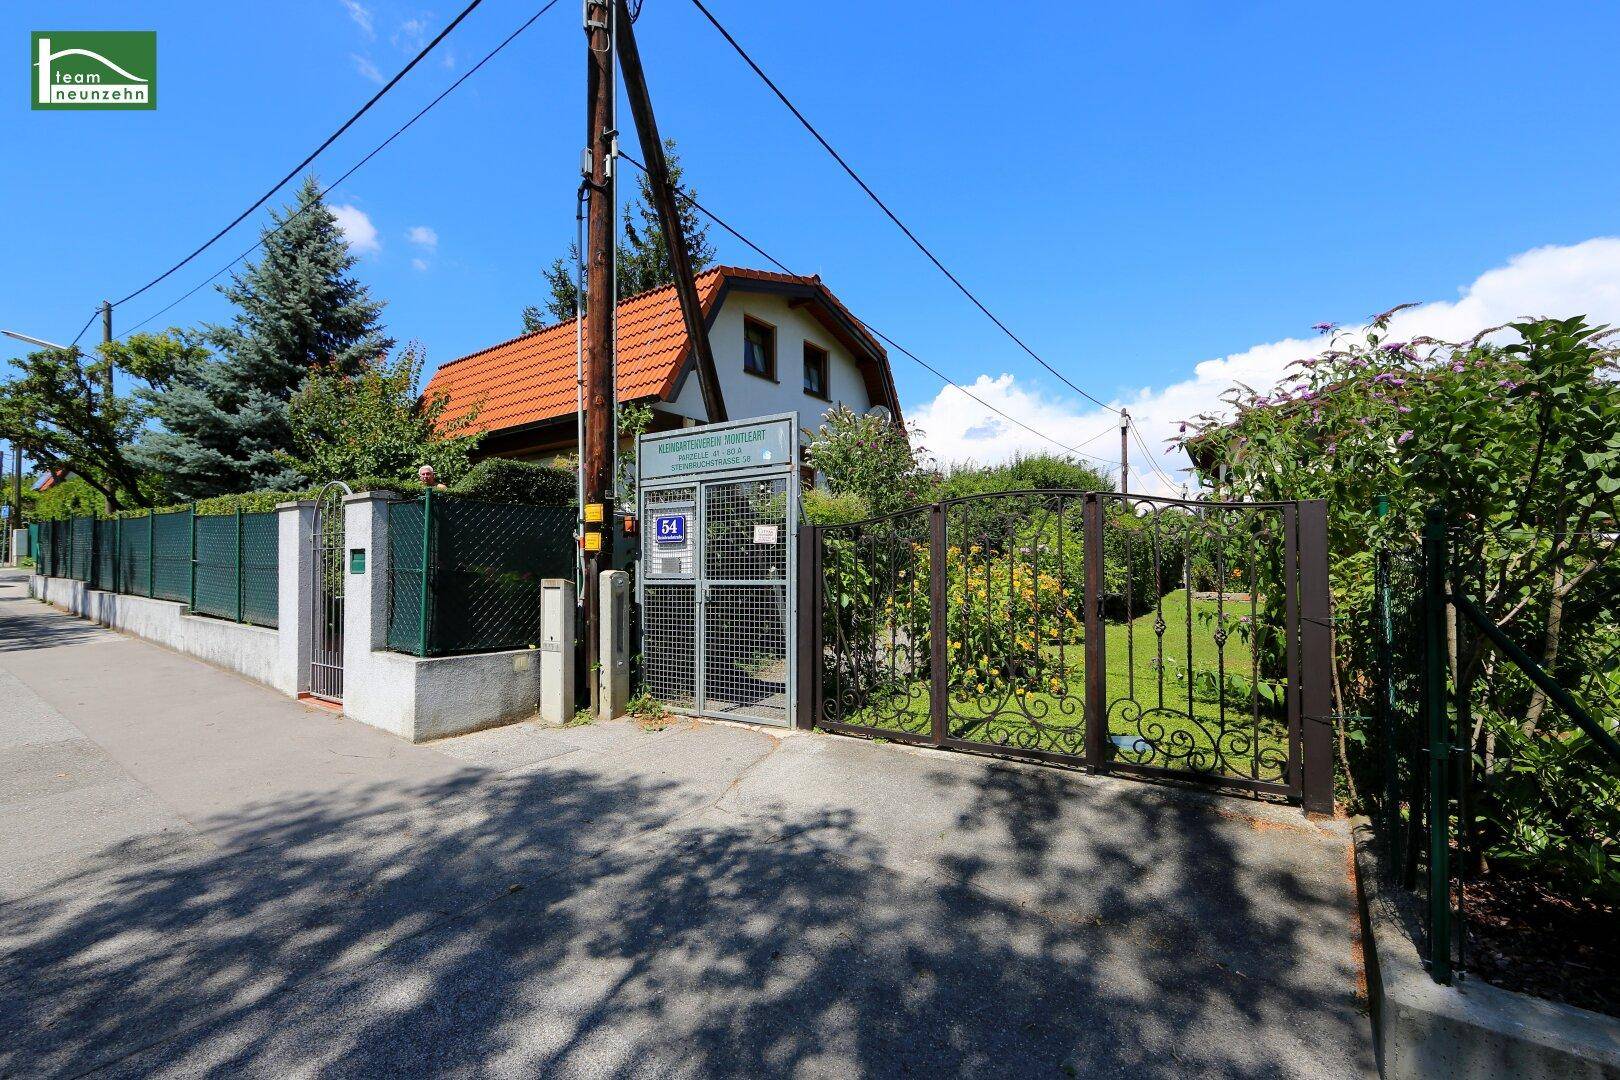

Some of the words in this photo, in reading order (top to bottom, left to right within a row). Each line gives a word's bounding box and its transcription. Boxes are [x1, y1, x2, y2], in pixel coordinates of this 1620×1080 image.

[658, 435, 722, 454] KLEINGARTENVEREIN
[724, 429, 766, 446] MONTLEART
[671, 456, 740, 472] STEINBRUCHSTRASSE
[678, 451, 709, 462] PARZELLE
[661, 519, 678, 534] 54
